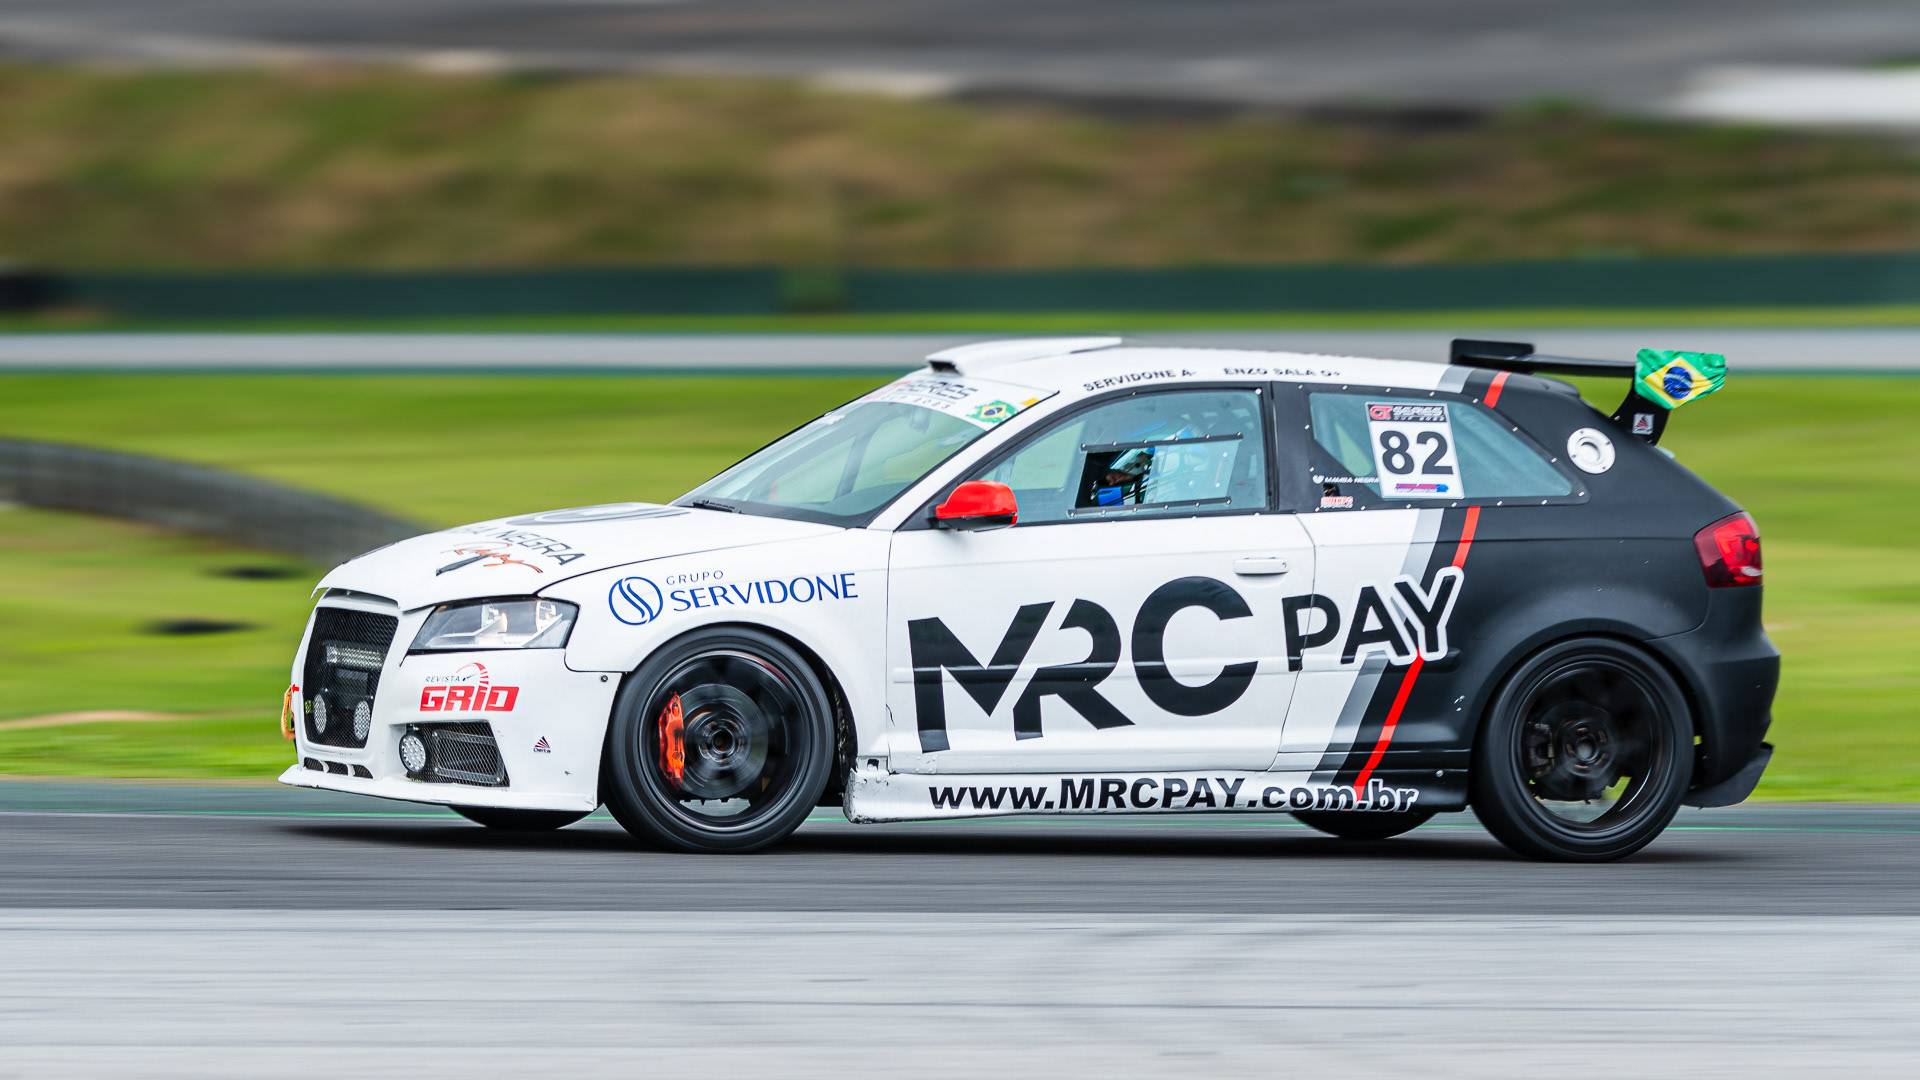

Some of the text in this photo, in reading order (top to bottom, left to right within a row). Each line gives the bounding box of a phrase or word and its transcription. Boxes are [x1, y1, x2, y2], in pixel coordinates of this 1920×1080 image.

[1083, 369, 1176, 392] SERVIDONE
[1223, 367, 1268, 376] ENZO
[1274, 368, 1315, 376] SALA
[1370, 405, 1443, 420] GT SERIES
[1379, 430, 1454, 475] 82
[1324, 476, 1353, 484] MAMBA
[666, 570, 724, 585] GRUPO
[670, 572, 859, 612] SERVIDONE
[908, 573, 1459, 754] MRC PAY
[424, 675, 461, 683] REVISTA
[928, 778, 1420, 812] www.MRCPAY.com.br
